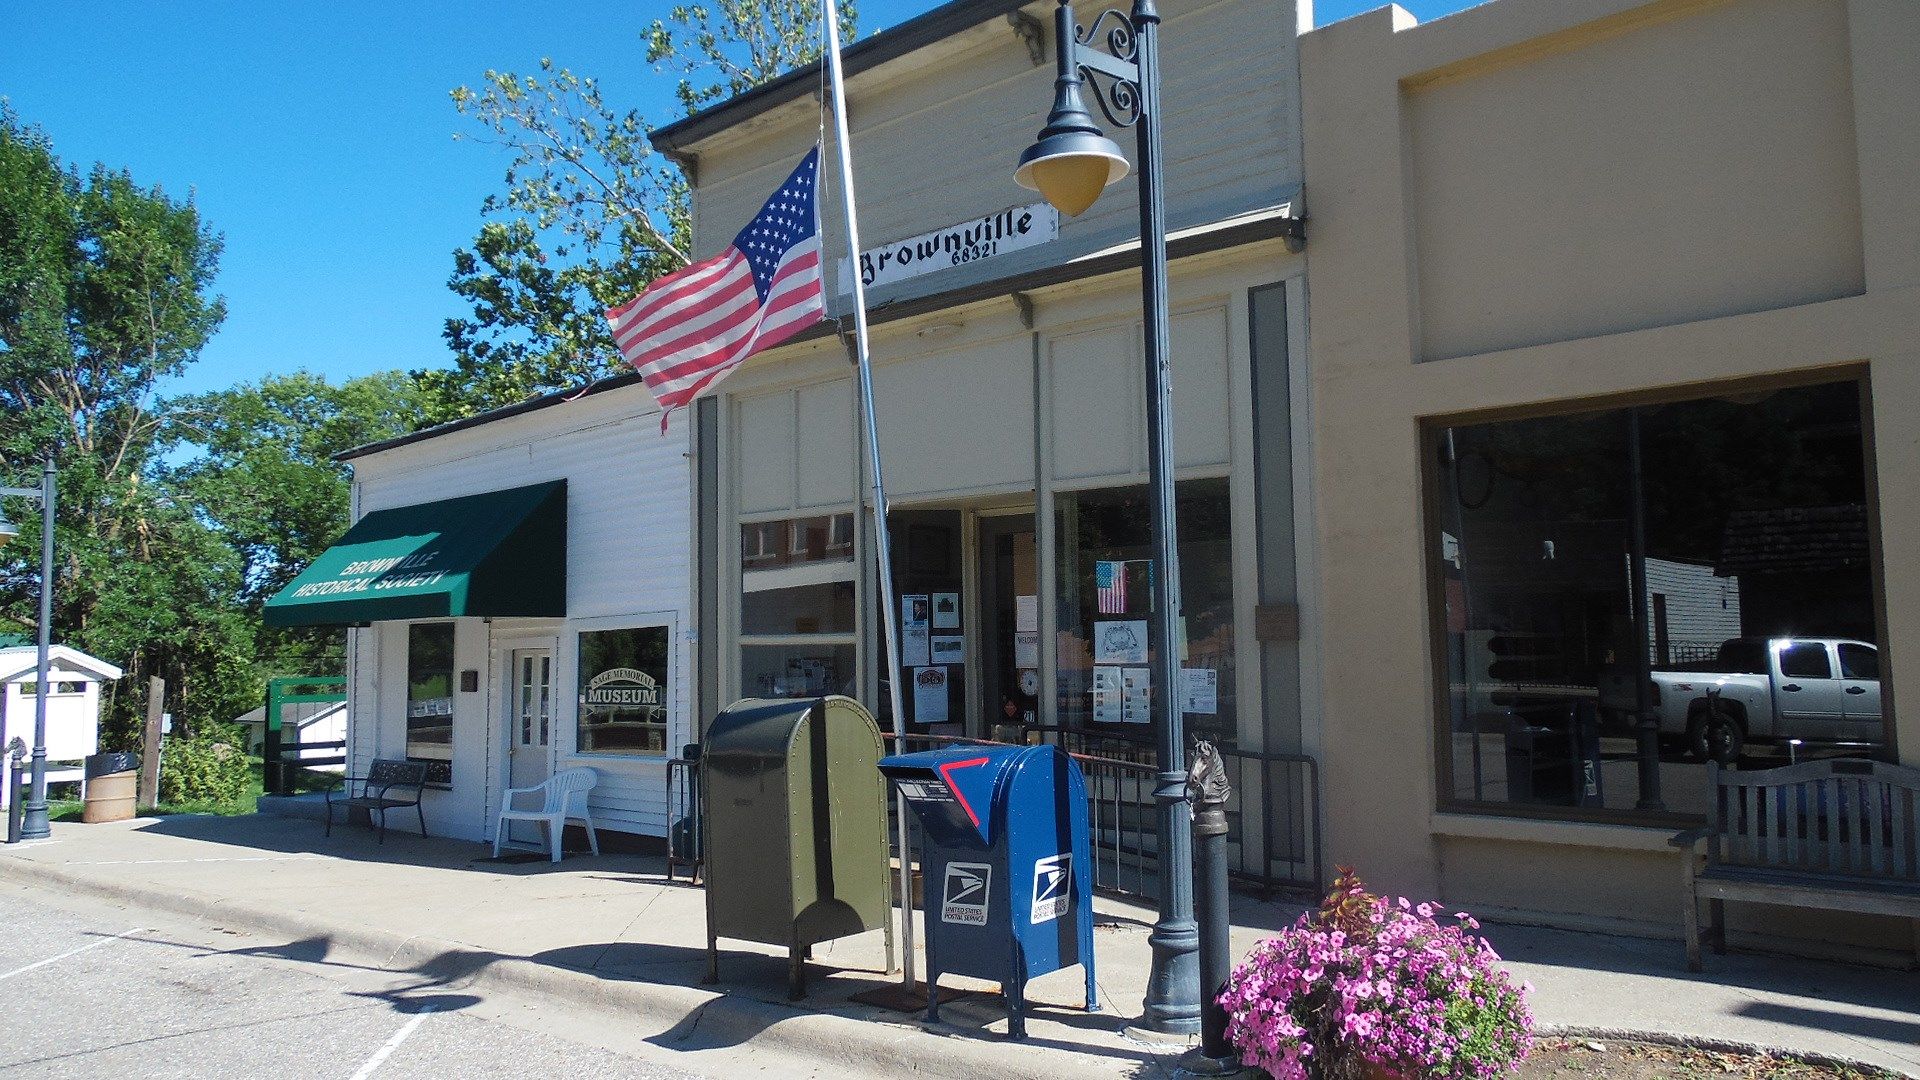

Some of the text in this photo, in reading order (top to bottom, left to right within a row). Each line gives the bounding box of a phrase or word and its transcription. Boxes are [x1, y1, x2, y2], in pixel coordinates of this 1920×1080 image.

[860, 210, 1032, 285] Brownville
[951, 241, 997, 266] 68321
[340, 551, 439, 576] BROWNVILLE
[291, 569, 450, 597] HISTORICAL SOCIETY
[592, 669, 655, 686] SAGE MEMORIAL
[588, 689, 657, 703] MUSEUM
